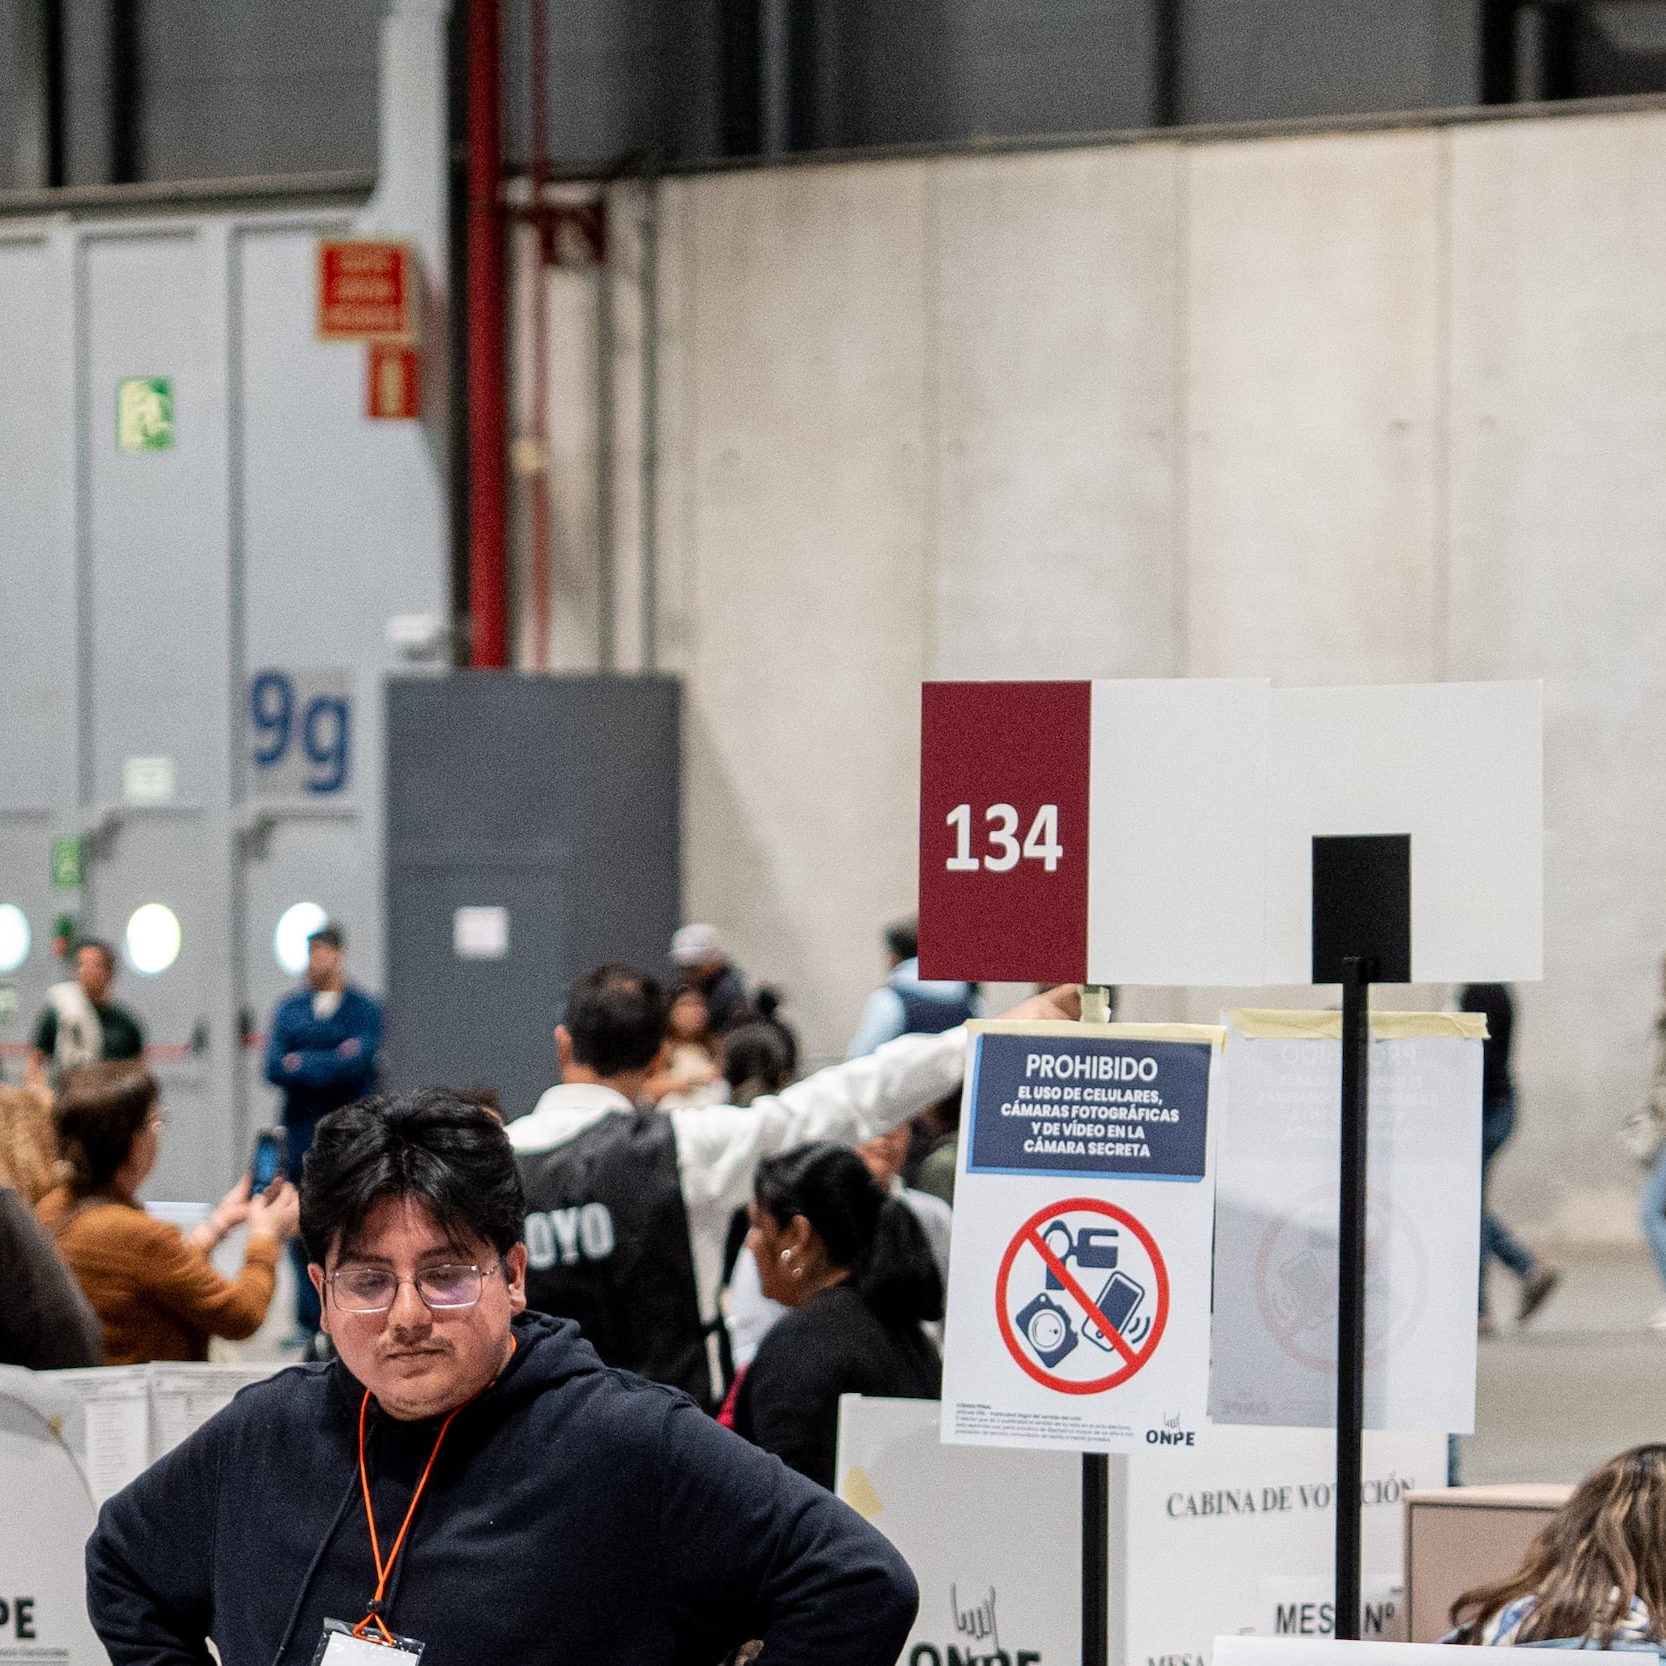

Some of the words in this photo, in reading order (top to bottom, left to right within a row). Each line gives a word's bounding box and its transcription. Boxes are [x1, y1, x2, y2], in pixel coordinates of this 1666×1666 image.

[251, 670, 349, 794] 9g
[945, 802, 1064, 873] 134
[1026, 1053, 1159, 1082] PROHIBIDO
[1018, 1086, 1032, 1099] EL
[1034, 1087, 1062, 1100] USO
[1063, 1087, 1082, 1101] DE
[1083, 1088, 1164, 1106] CELULARES,
[1001, 1100, 1069, 1119] CÁMARAS
[1071, 1104, 1180, 1123] FOTOGRÁFICAS
[1031, 1122, 1042, 1135] Y
[1043, 1122, 1060, 1136] DE
[1062, 1119, 1105, 1138] VÍDEO
[1107, 1124, 1126, 1139] EN
[1127, 1126, 1145, 1139] LA
[1023, 1136, 1086, 1155] CÁMARA
[1088, 1142, 1151, 1158] SECRETA
[524, 1202, 616, 1271] OYO
[1145, 1429, 1196, 1446] ONPE
[1166, 1488, 1256, 1518] CABINA
[1262, 1486, 1293, 1512] DE
[1274, 1602, 1336, 1635] MES
[1363, 1601, 1396, 1634] Nº
